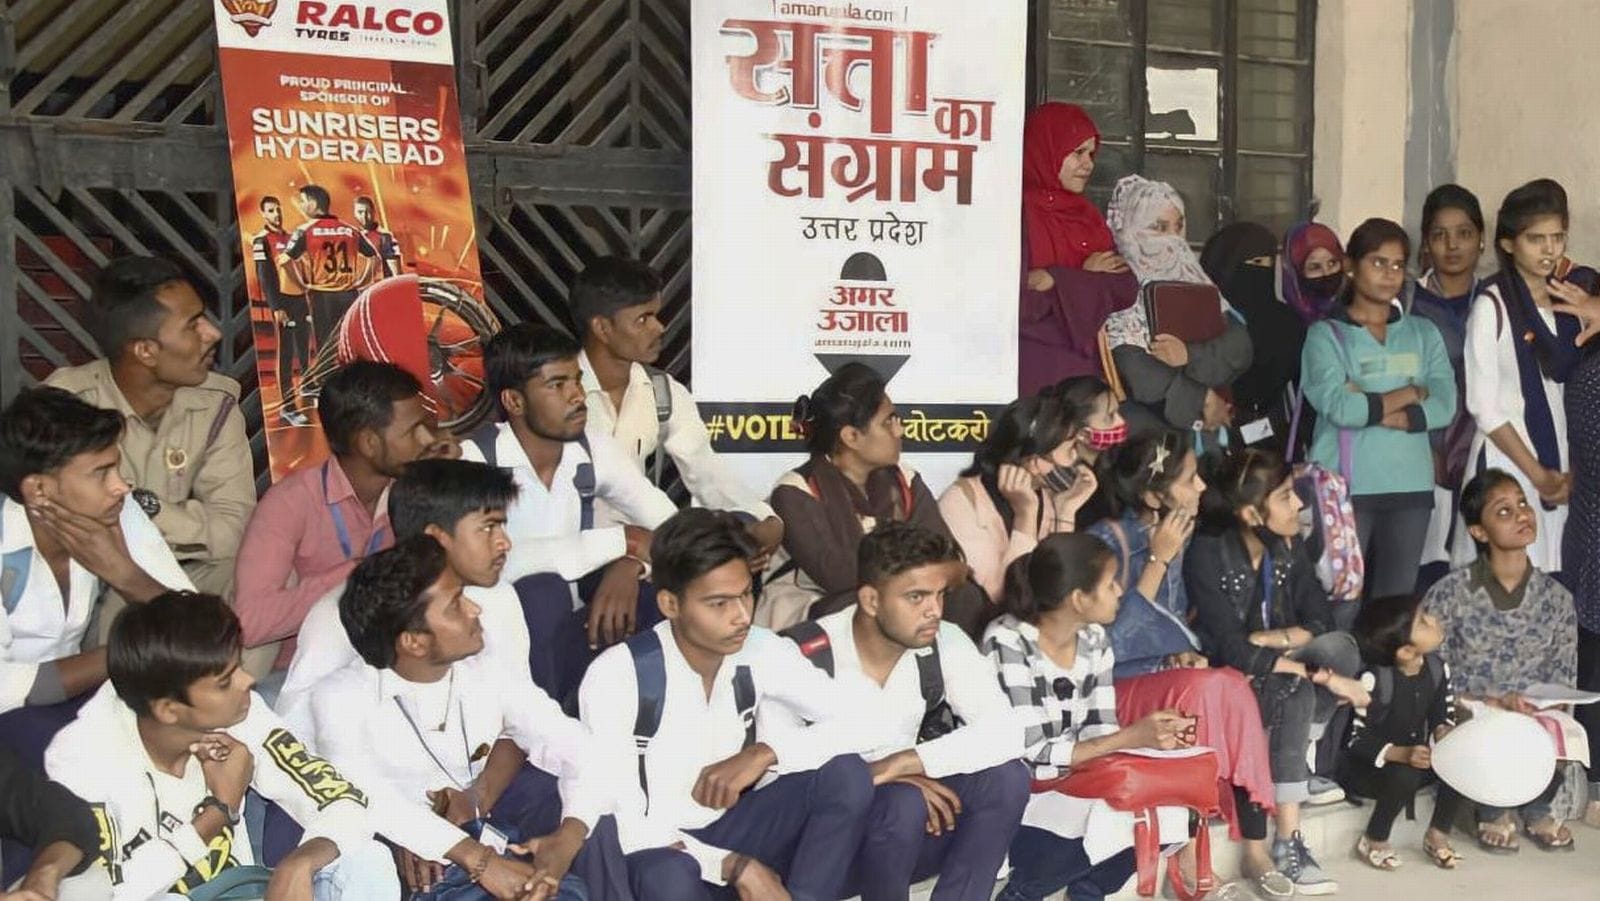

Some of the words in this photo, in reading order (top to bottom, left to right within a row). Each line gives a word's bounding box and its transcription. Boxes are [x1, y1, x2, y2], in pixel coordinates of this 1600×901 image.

[297, 1, 444, 36] RALCO
[780, 3, 895, 21] amarla.com
[295, 28, 350, 41] TYRES
[280, 74, 331, 91] PROUD
[333, 79, 407, 95] PRINCIPAL
[299, 90, 368, 105] SPONSOR
[370, 94, 390, 106] OF
[251, 108, 442, 143] SUNRISERS
[932, 98, 996, 141] का
[254, 136, 445, 166] HYDERABAD
[766, 111, 978, 205] संग्राम
[800, 216, 859, 240] उत्तर
[869, 212, 928, 245] प्रदेश
[321, 241, 353, 274] 31
[829, 286, 896, 307] अमर
[817, 309, 908, 333] उजाला
